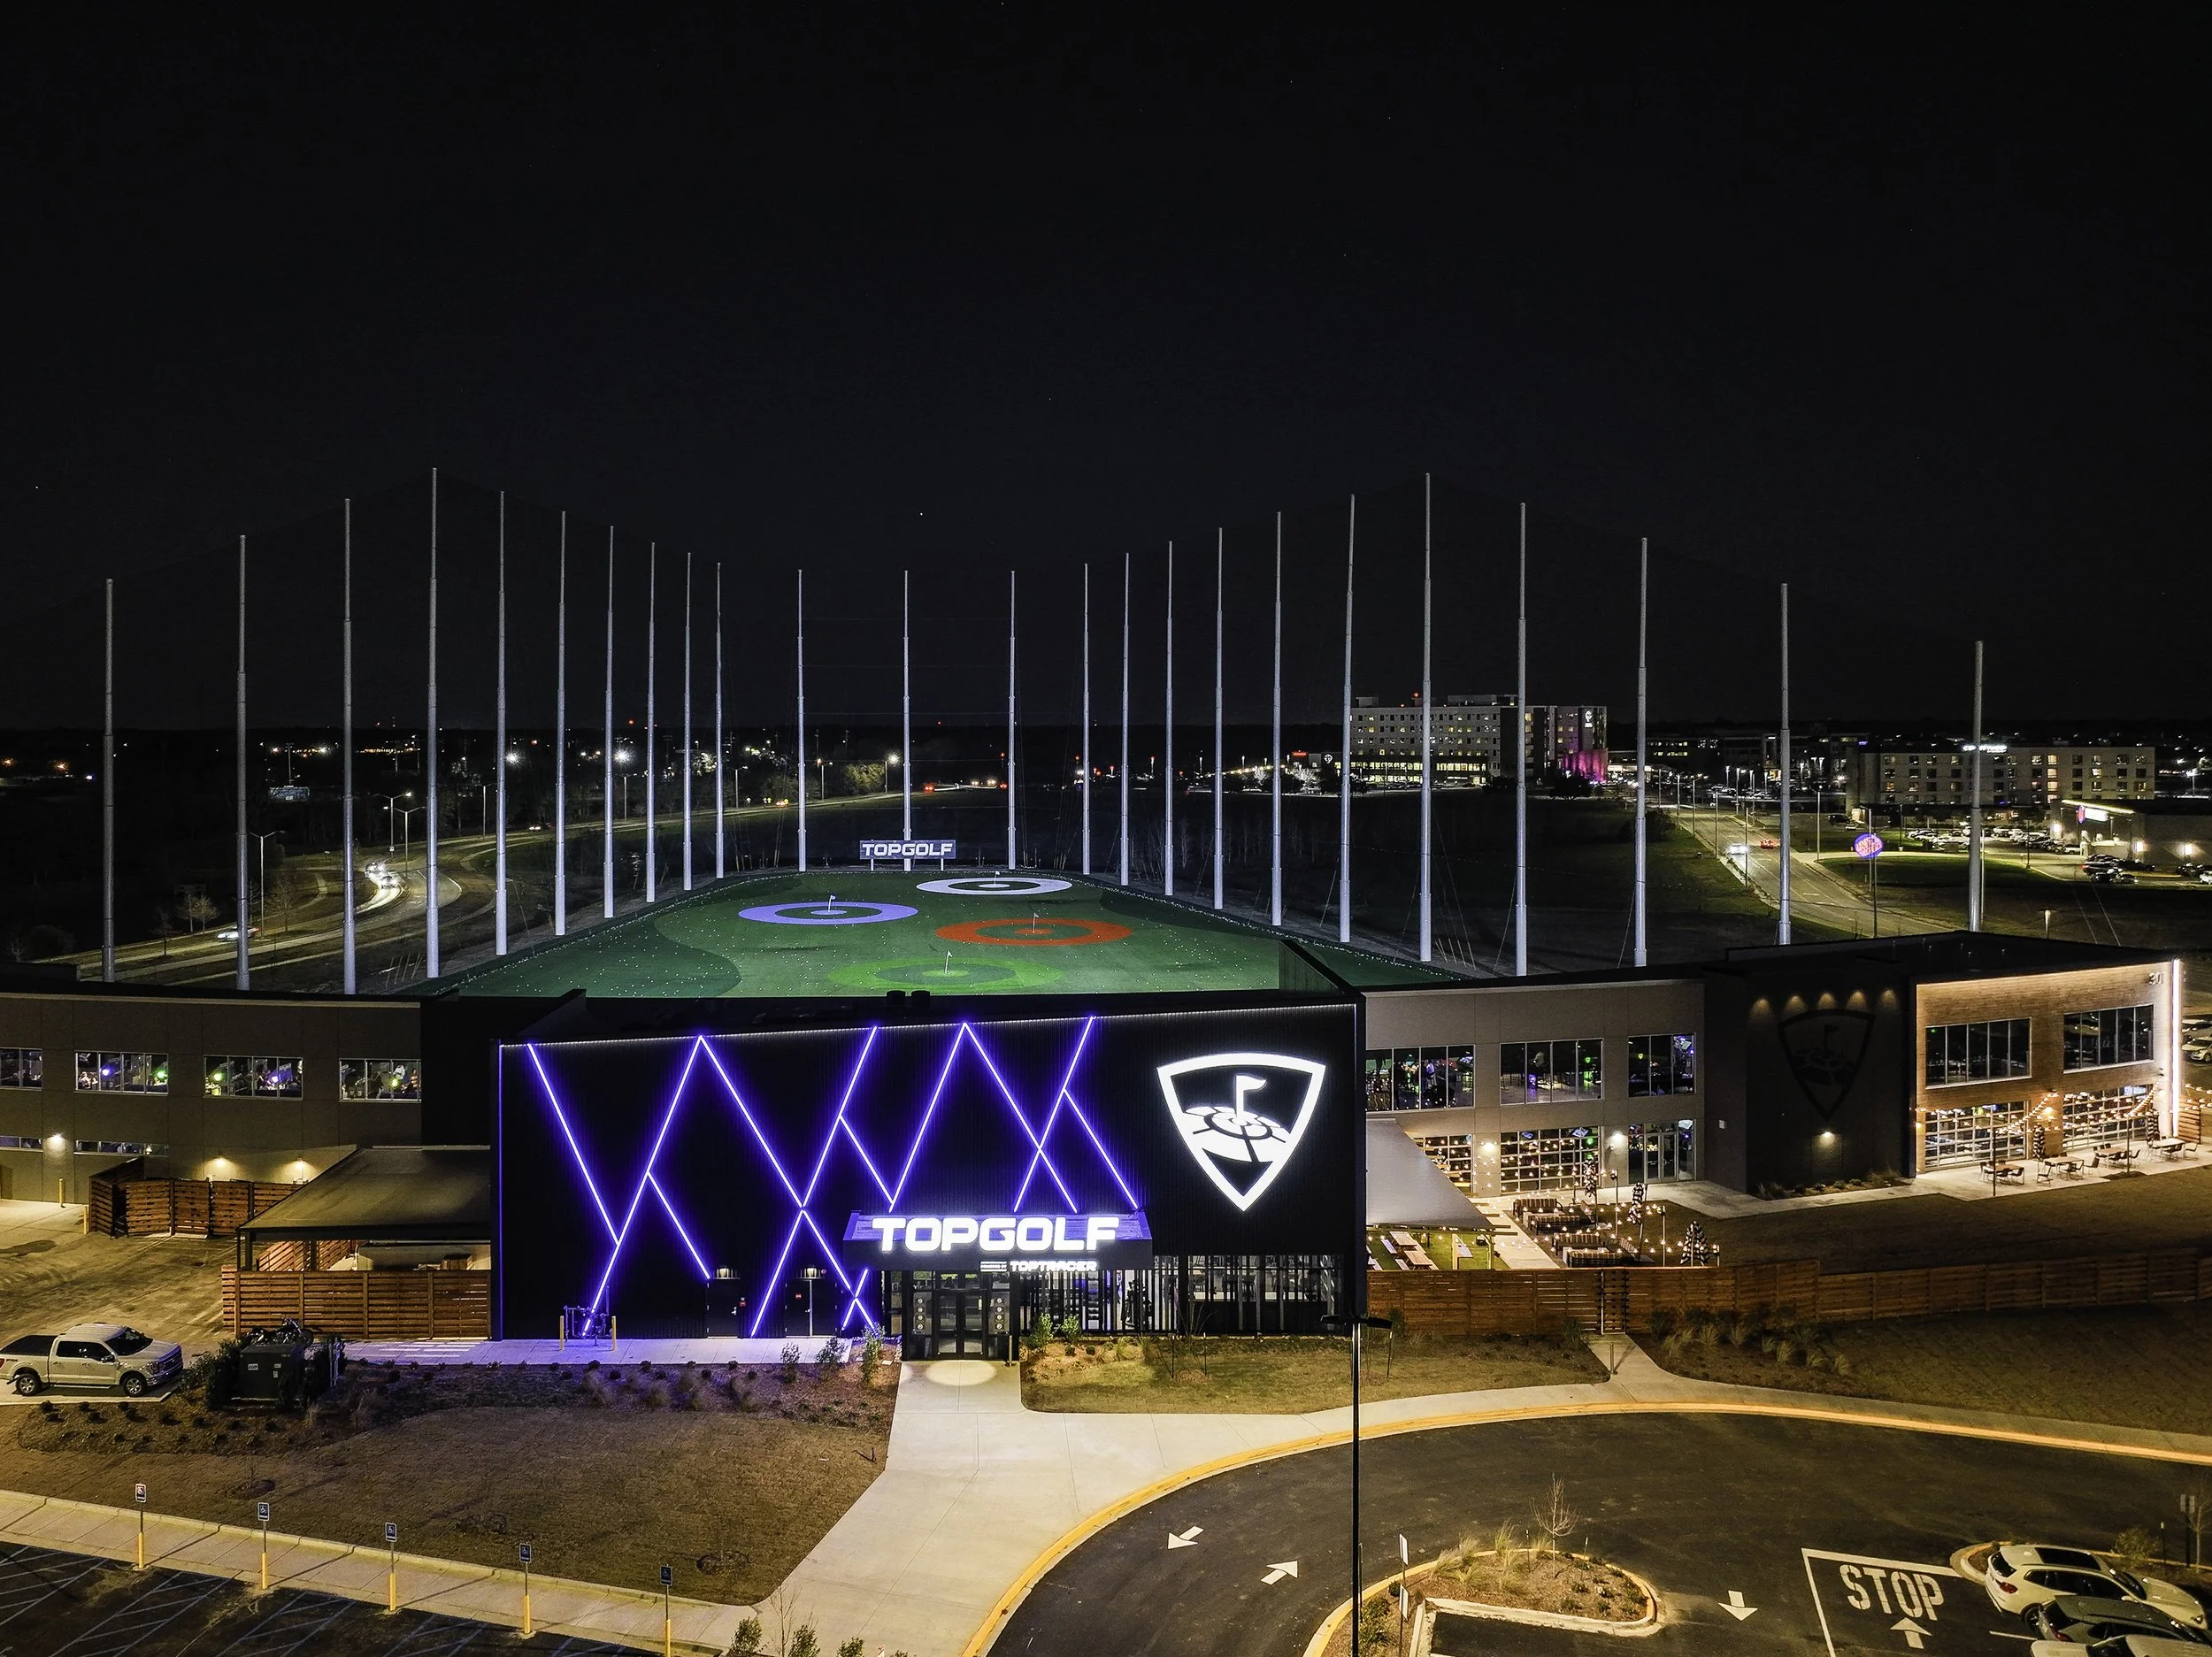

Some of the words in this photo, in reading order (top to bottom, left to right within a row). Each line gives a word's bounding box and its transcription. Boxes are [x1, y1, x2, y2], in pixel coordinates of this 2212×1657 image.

[863, 843, 953, 856] TOPGOLF
[872, 1217, 1119, 1252] TOPGOLF
[1010, 1261, 1097, 1272] TOPTRACER
[1839, 1564, 1944, 1621] STOP
